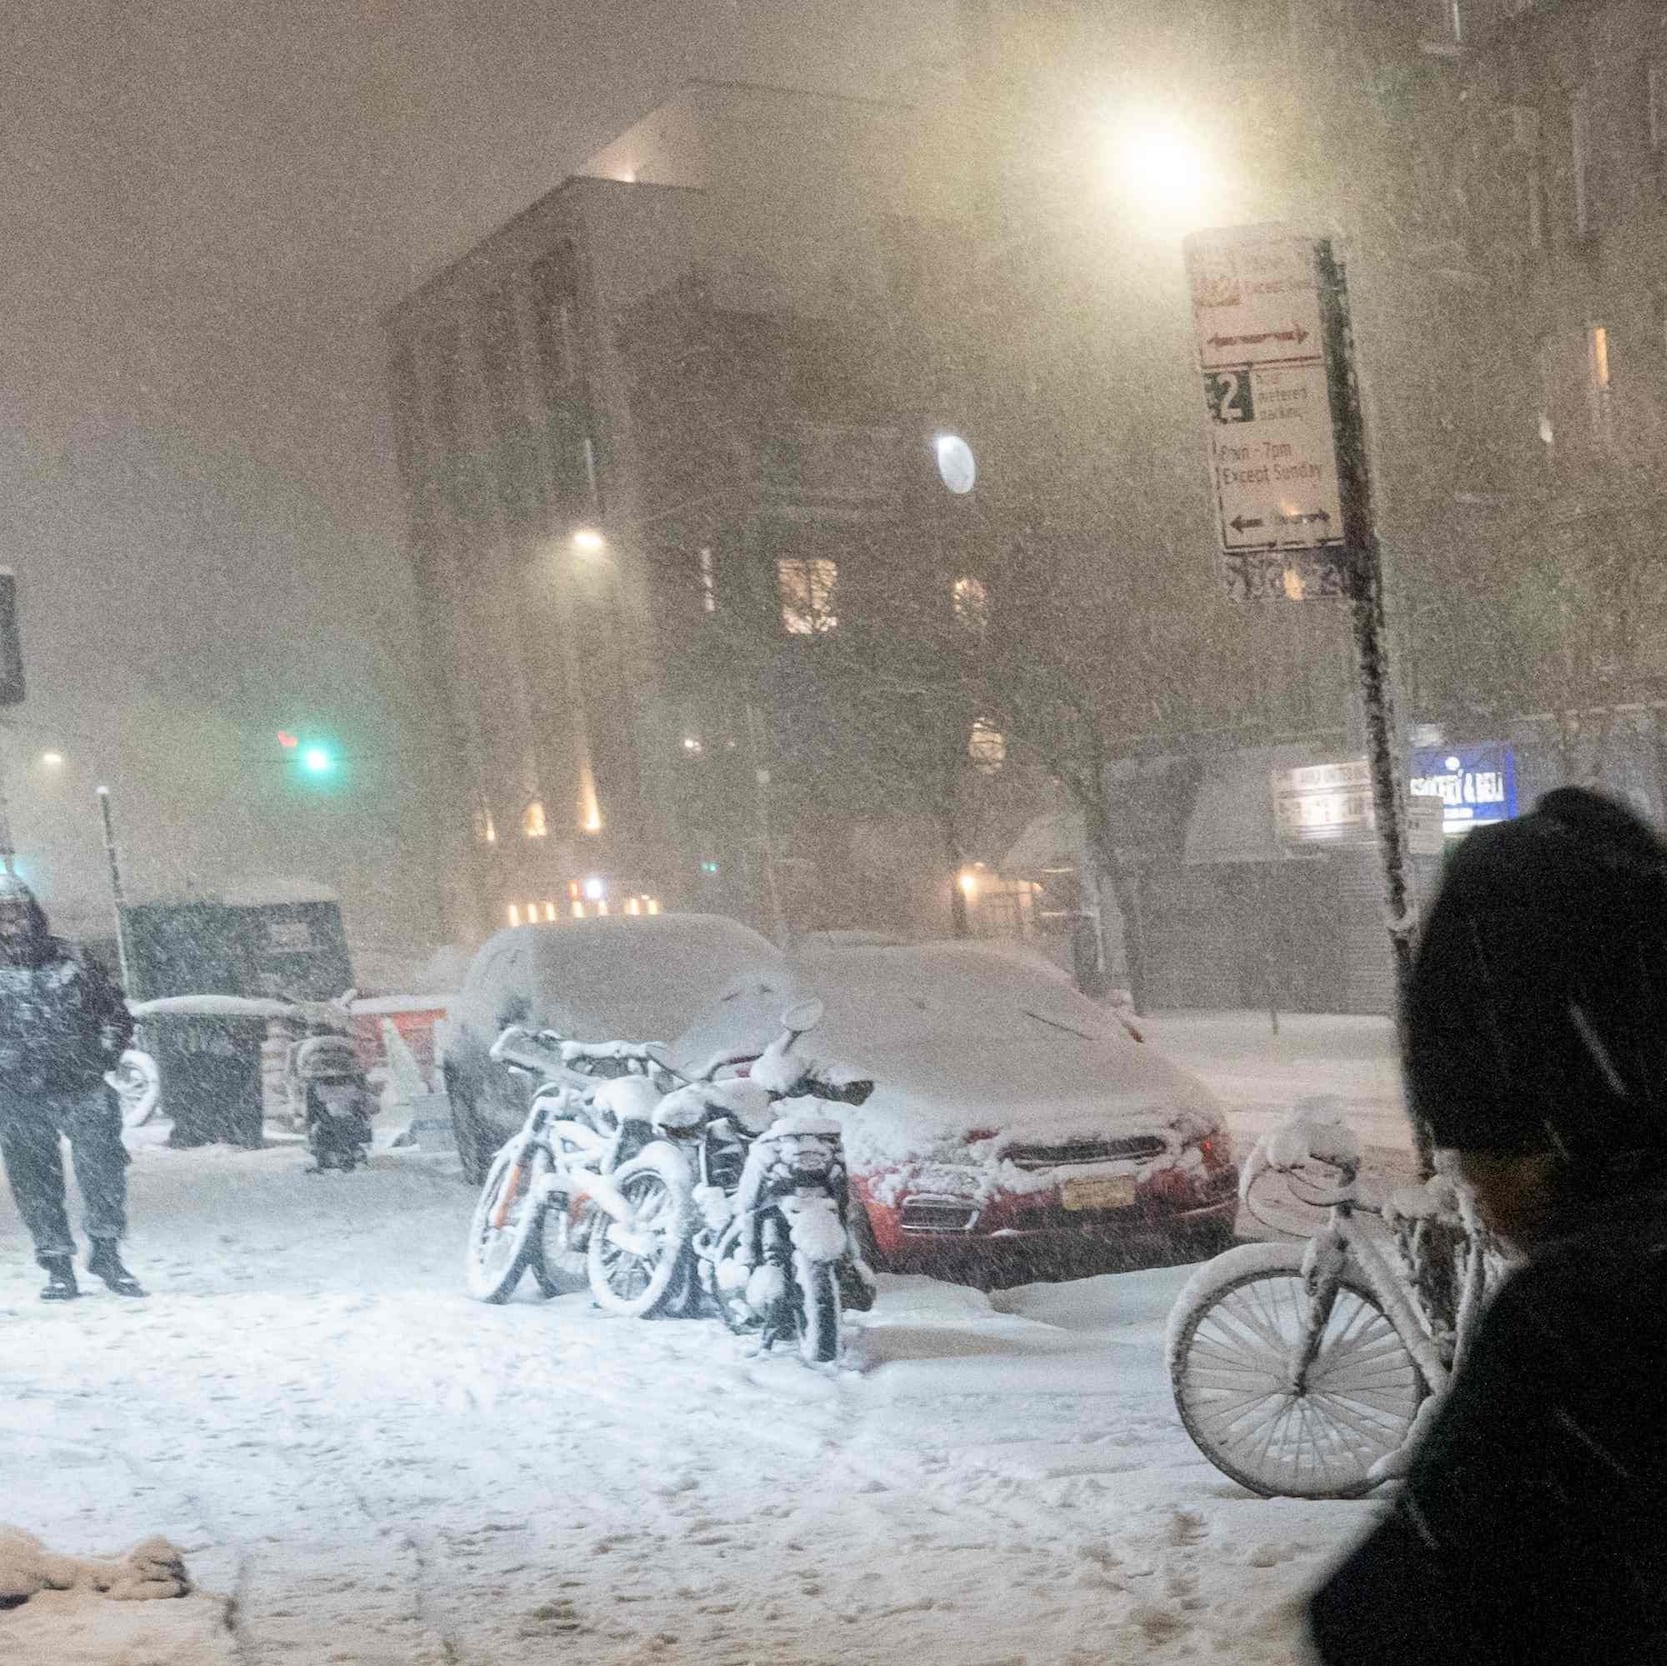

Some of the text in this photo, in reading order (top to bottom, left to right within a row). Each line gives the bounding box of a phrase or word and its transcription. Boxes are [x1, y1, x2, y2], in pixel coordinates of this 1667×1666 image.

[1217, 373, 1243, 419] 2
[1222, 461, 1322, 486] Except Sunday
